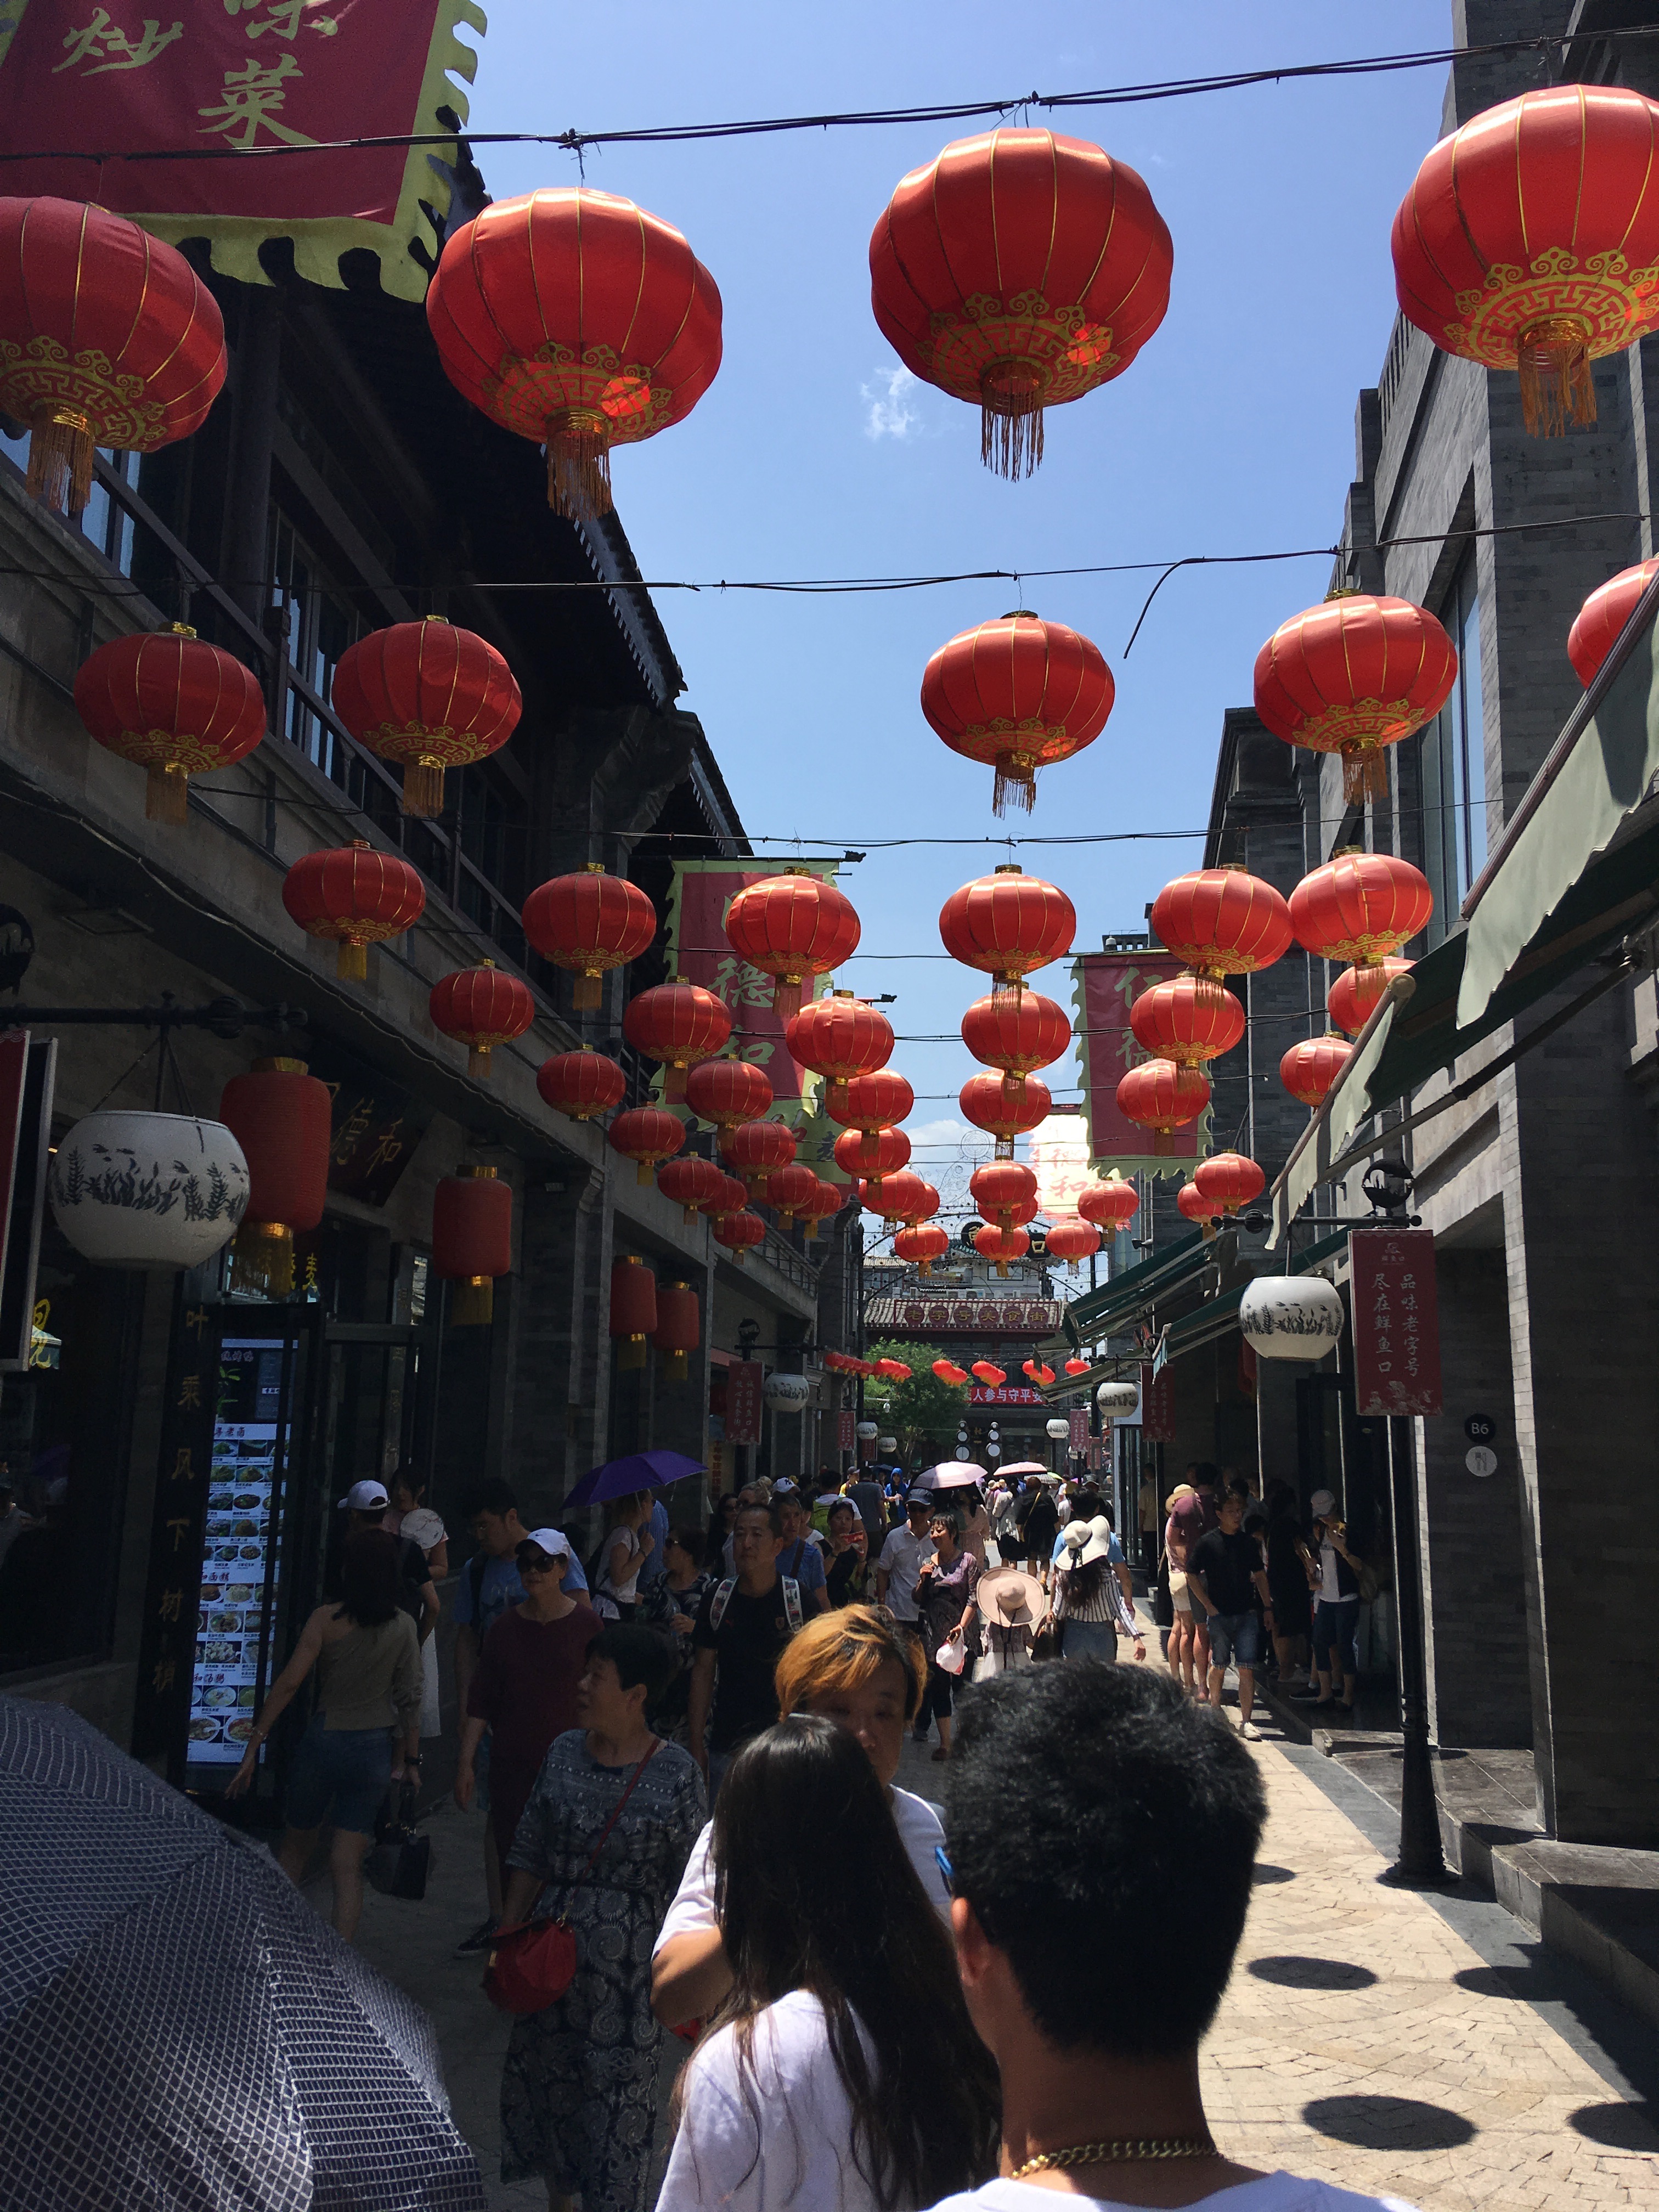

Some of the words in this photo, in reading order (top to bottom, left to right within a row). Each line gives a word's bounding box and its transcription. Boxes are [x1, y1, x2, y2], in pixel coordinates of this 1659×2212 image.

[326, 1082, 404, 1179] 德和
[907, 1309, 1046, 1323] 老字号美食街
[1371, 1273, 1393, 1373] 尽在鲜鱼口
[1400, 1273, 1420, 1378] 品味老字号
[966, 1388, 1043, 1403] 人参与守平安
[1471, 1423, 1489, 1435] B6
